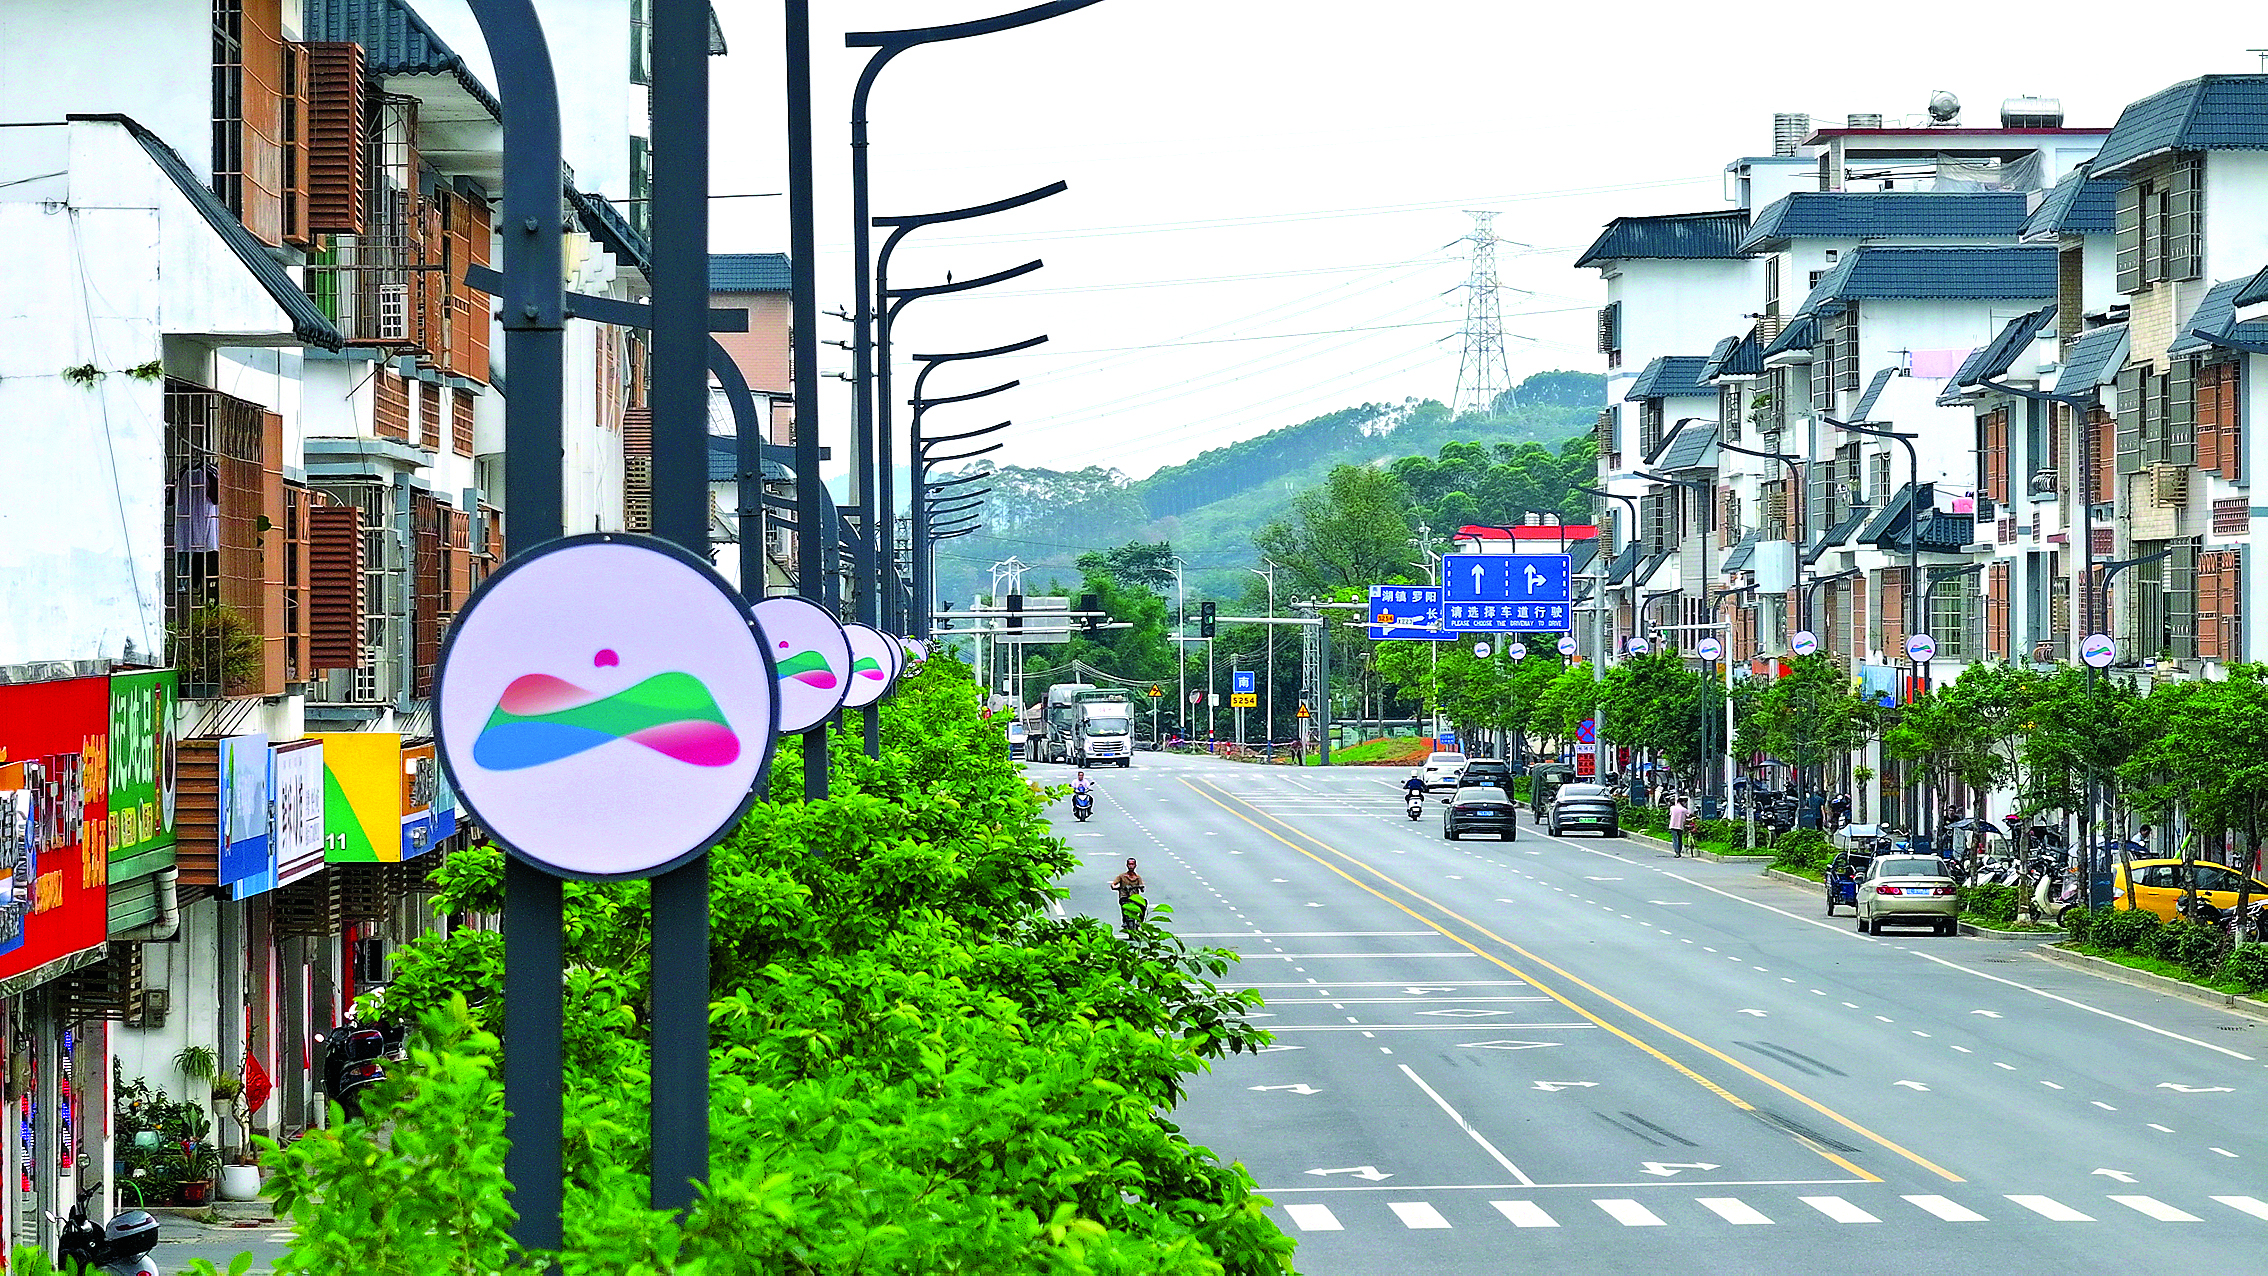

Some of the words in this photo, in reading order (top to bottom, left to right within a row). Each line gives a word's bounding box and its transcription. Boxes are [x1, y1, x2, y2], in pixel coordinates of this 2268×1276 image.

[1382, 590, 1407, 602] 湖镇
[1412, 590, 1437, 602] 罗阳
[1451, 606, 1563, 618] 请选择车道行驶
[1238, 676, 1250, 688] 南
